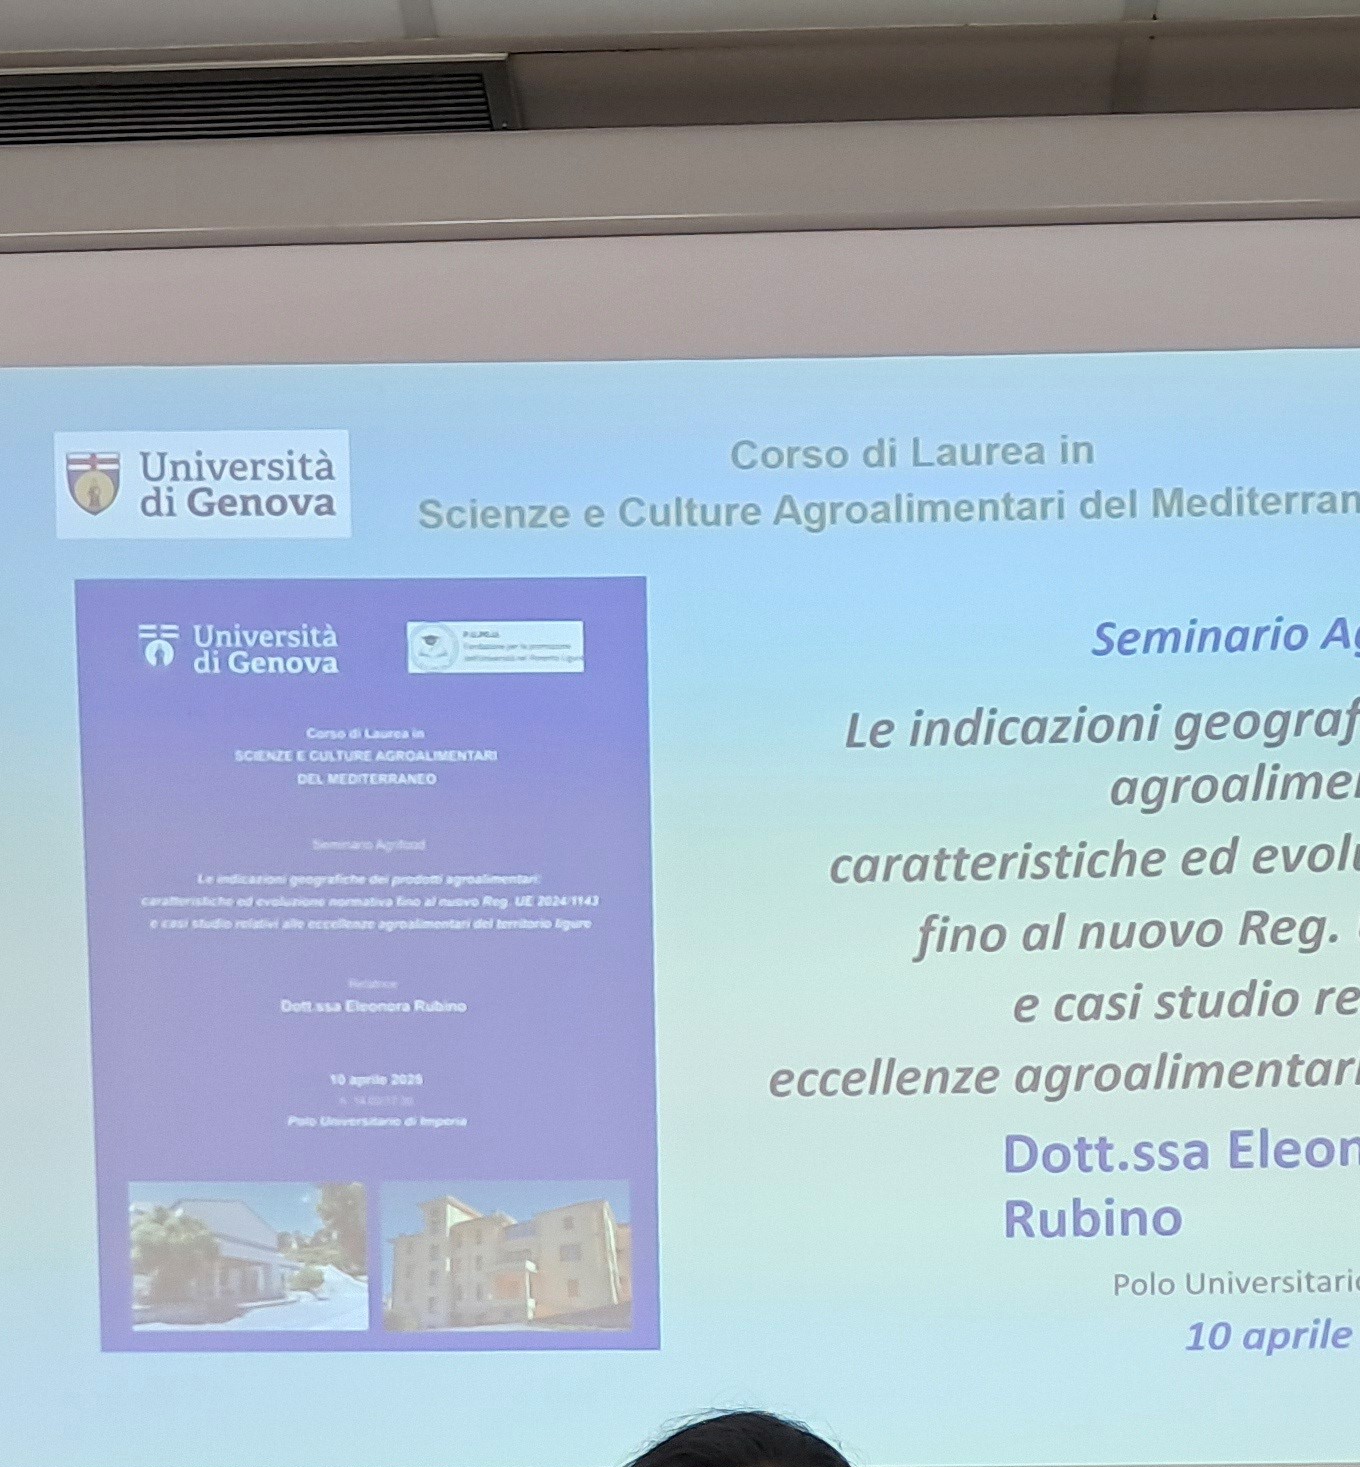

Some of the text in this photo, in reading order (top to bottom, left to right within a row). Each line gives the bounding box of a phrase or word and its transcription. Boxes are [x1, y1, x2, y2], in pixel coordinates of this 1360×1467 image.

[140, 449, 335, 482] Università
[731, 434, 1094, 470] Corso di Laurea in
[141, 487, 336, 517] di Genova
[418, 498, 570, 529] Scienze
[584, 508, 605, 527] e
[619, 496, 761, 527] Culture
[772, 490, 1064, 533] Agroalimentari
[1079, 488, 1137, 520] del
[193, 623, 338, 647] Università
[1091, 616, 1309, 656] Seminario
[193, 650, 338, 673] di Genova
[306, 728, 346, 739] Corso
[364, 728, 409, 738] Laurea
[846, 711, 895, 748] Le
[909, 703, 1163, 747] indicazioni
[235, 750, 292, 762] SCIENZE
[310, 750, 371, 762] CULTURE
[376, 749, 497, 761] AGROALIMENTARI
[297, 773, 436, 785] DEL MEDITERRANEO
[830, 839, 1166, 883] caratteristiche
[1181, 836, 1240, 876] ed
[912, 914, 1006, 963] fino
[1022, 912, 1066, 950] al
[1078, 918, 1222, 950] nuovo
[1239, 910, 1339, 954] Reg.
[1013, 994, 1039, 1022] e
[1053, 982, 1143, 1021] casi
[1154, 979, 1300, 1019] studio
[769, 1058, 1000, 1097] eccellenze
[1005, 1134, 1209, 1172] Dott.ssa
[1005, 1197, 1182, 1238] Rubino
[1113, 1272, 1175, 1296] Polo
[1185, 1322, 1231, 1350] 10
[1243, 1319, 1353, 1355] aprile
